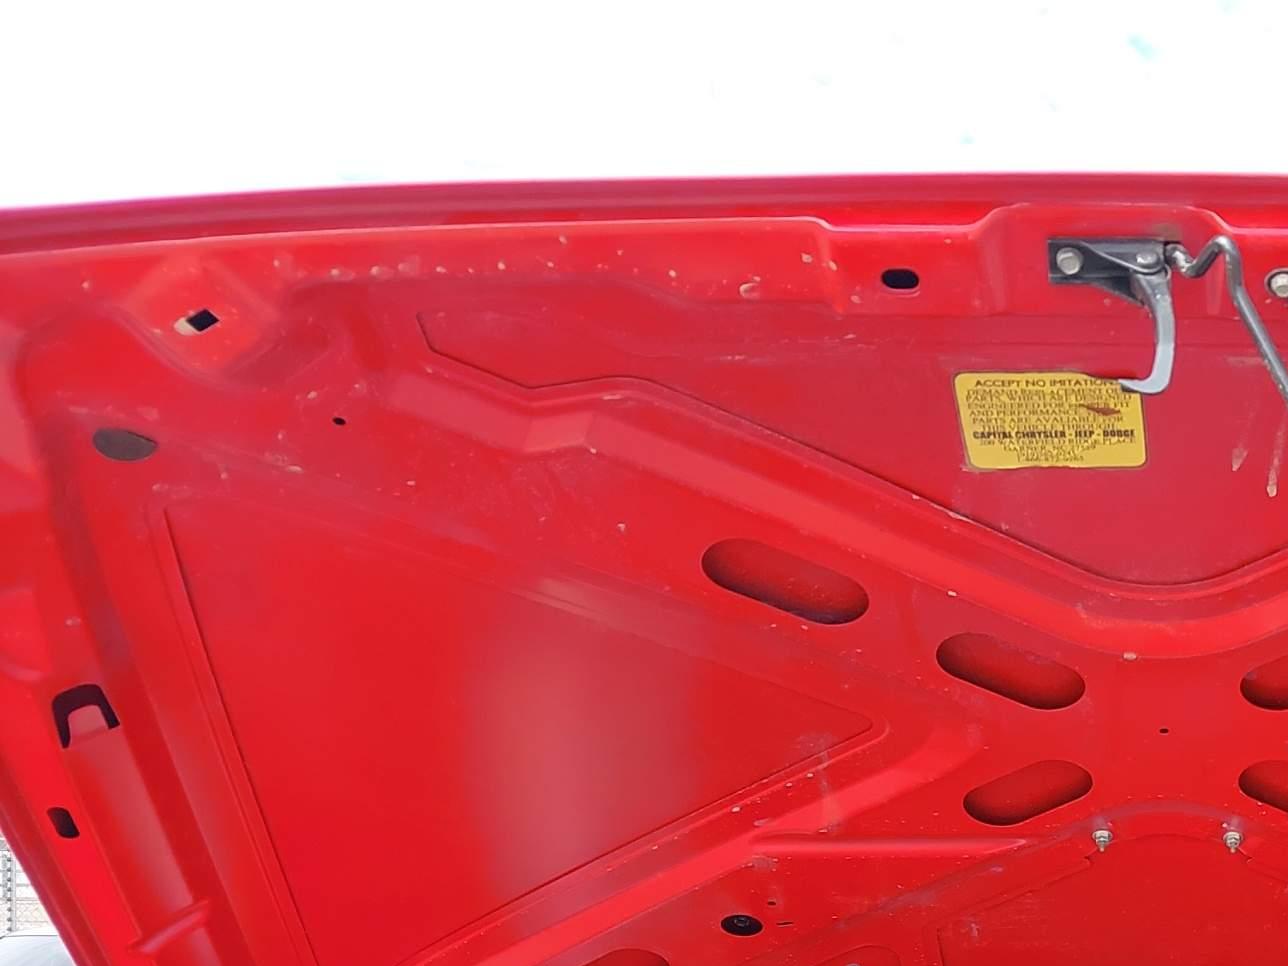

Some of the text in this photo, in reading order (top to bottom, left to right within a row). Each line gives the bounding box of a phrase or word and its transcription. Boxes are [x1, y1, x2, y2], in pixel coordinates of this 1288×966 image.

[975, 379, 1021, 388] ACCEPT
[1025, 379, 1046, 388] NO
[973, 431, 1014, 439] CAPITAL
[1015, 430, 1066, 439] CHRYSLER
[1074, 429, 1094, 438] JEEP
[1102, 429, 1135, 438] DODGE
